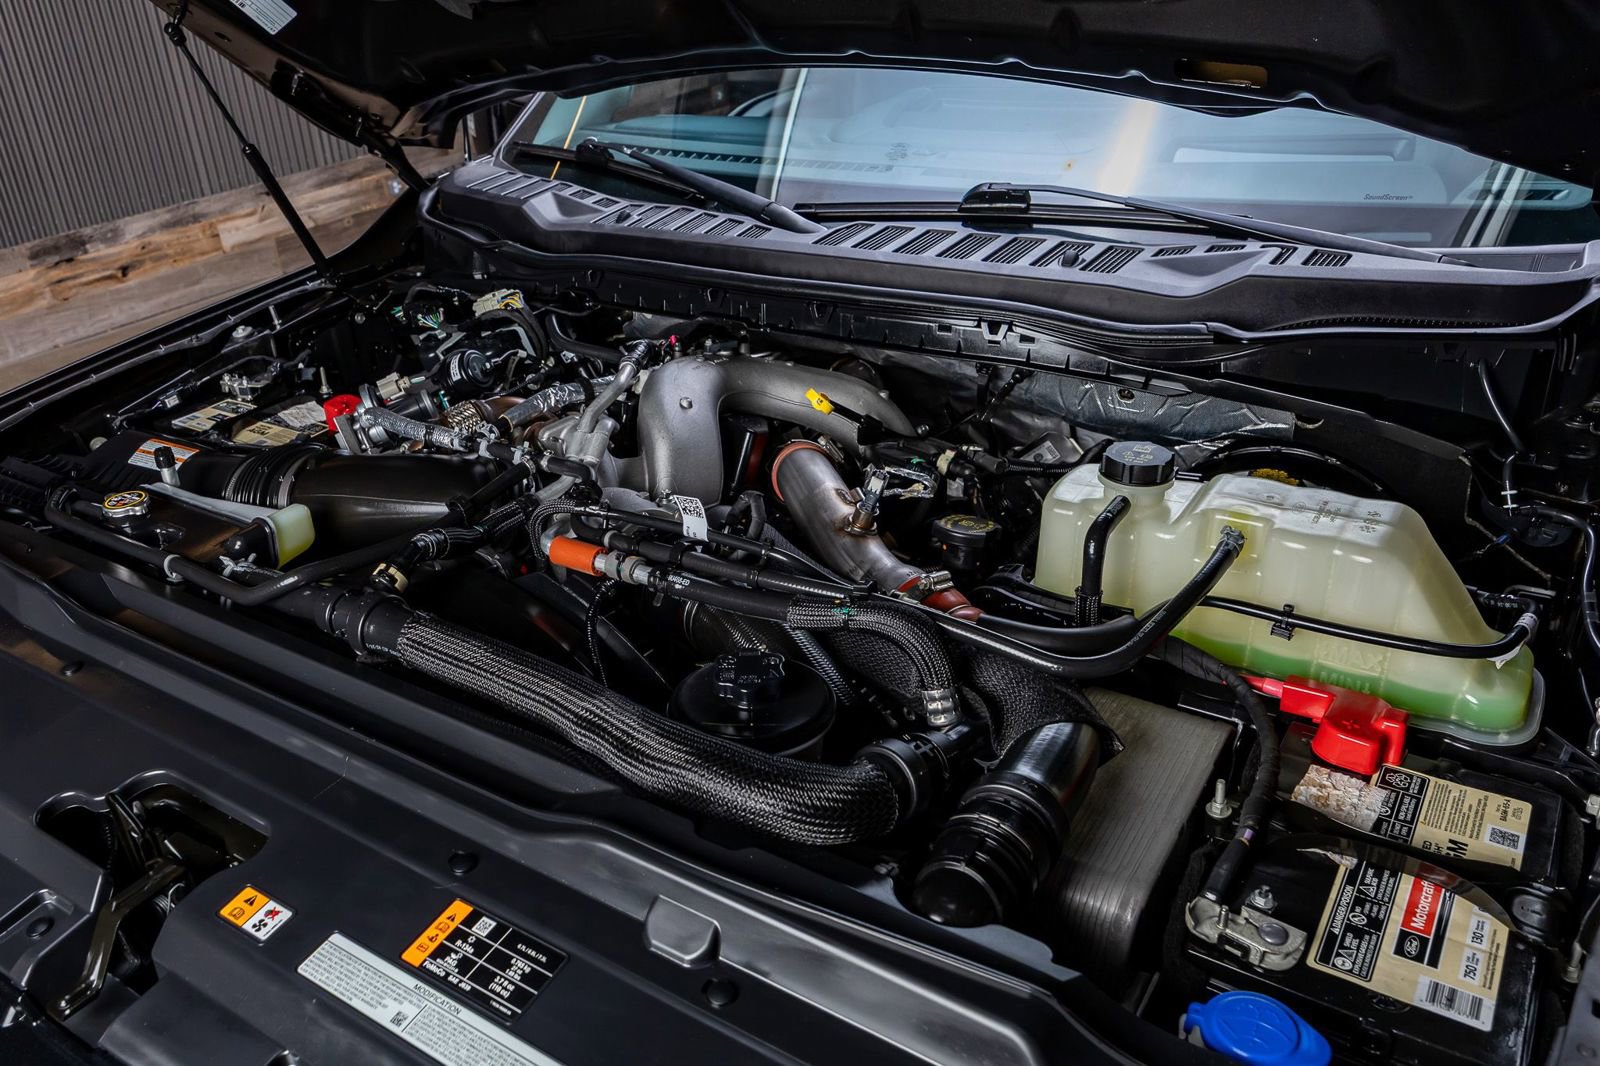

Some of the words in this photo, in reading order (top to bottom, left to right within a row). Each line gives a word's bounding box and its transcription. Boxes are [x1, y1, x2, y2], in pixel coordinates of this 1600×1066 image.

[1410, 880, 1435, 930] Motorcraft
[1472, 930, 1484, 945] 130
[455, 940, 474, 953] R-134a
[423, 961, 445, 976] FoMoCo
[444, 956, 457, 966] PAG
[1464, 964, 1477, 980] 750
[494, 976, 504, 984] 3.7
[413, 984, 462, 1015] MODIFICATION
